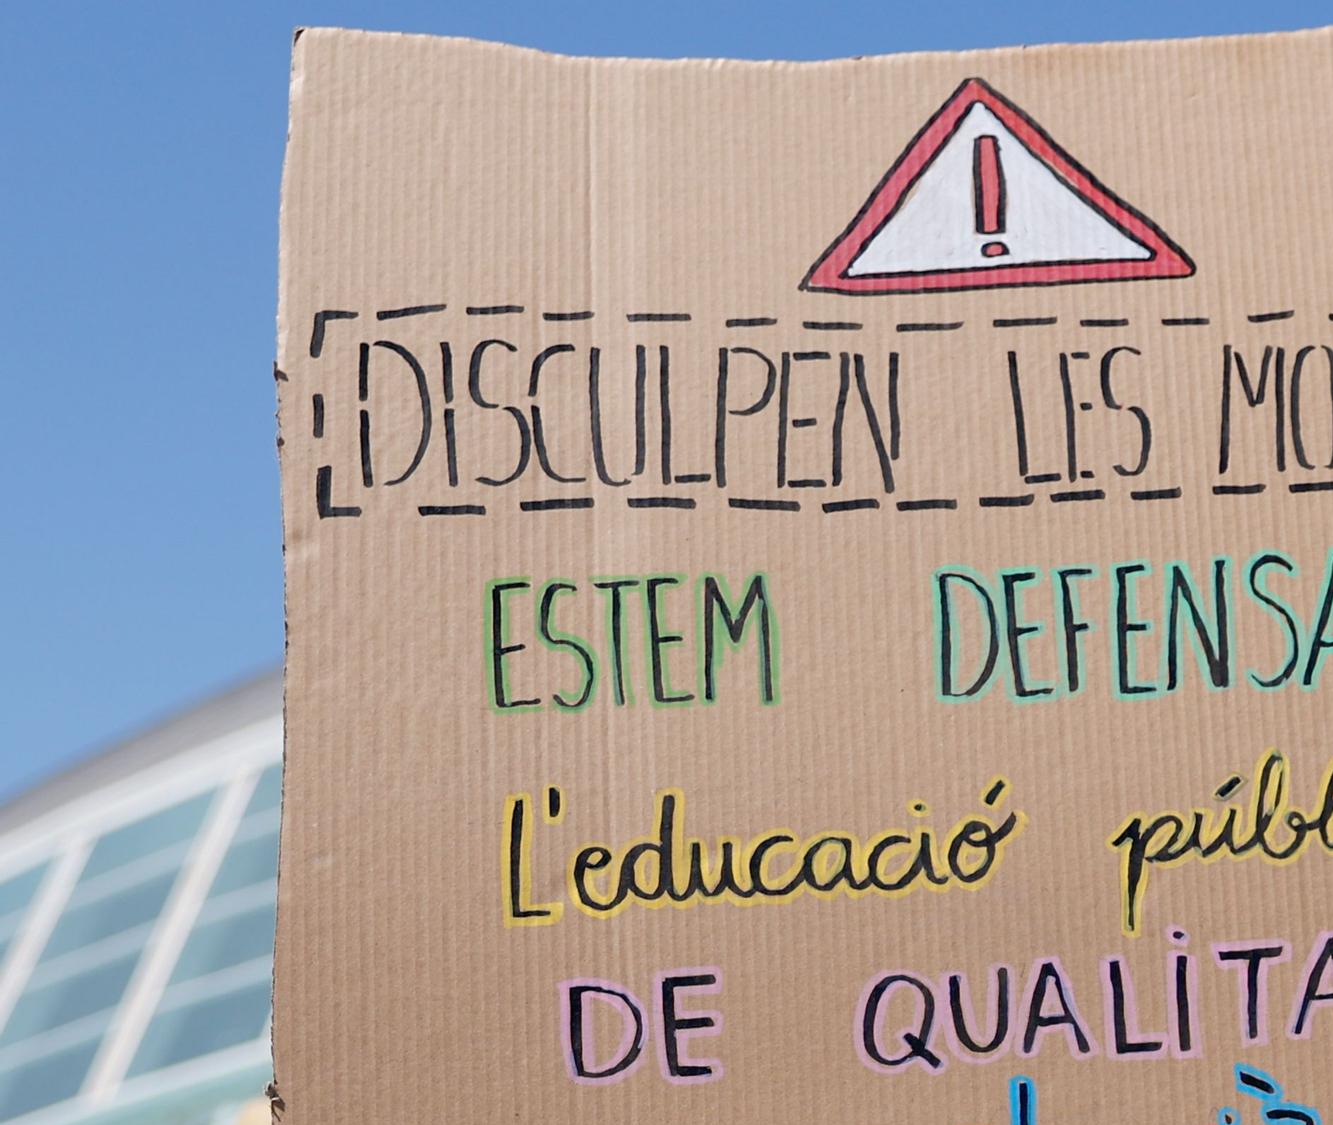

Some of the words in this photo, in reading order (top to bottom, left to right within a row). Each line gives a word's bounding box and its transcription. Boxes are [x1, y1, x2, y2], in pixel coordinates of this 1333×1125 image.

[357, 337, 902, 494] DISCULPEN
[1005, 344, 1153, 484] LES
[488, 572, 776, 711] ESTEM
[507, 777, 1020, 922] L'educació
[566, 971, 720, 1080] DE
